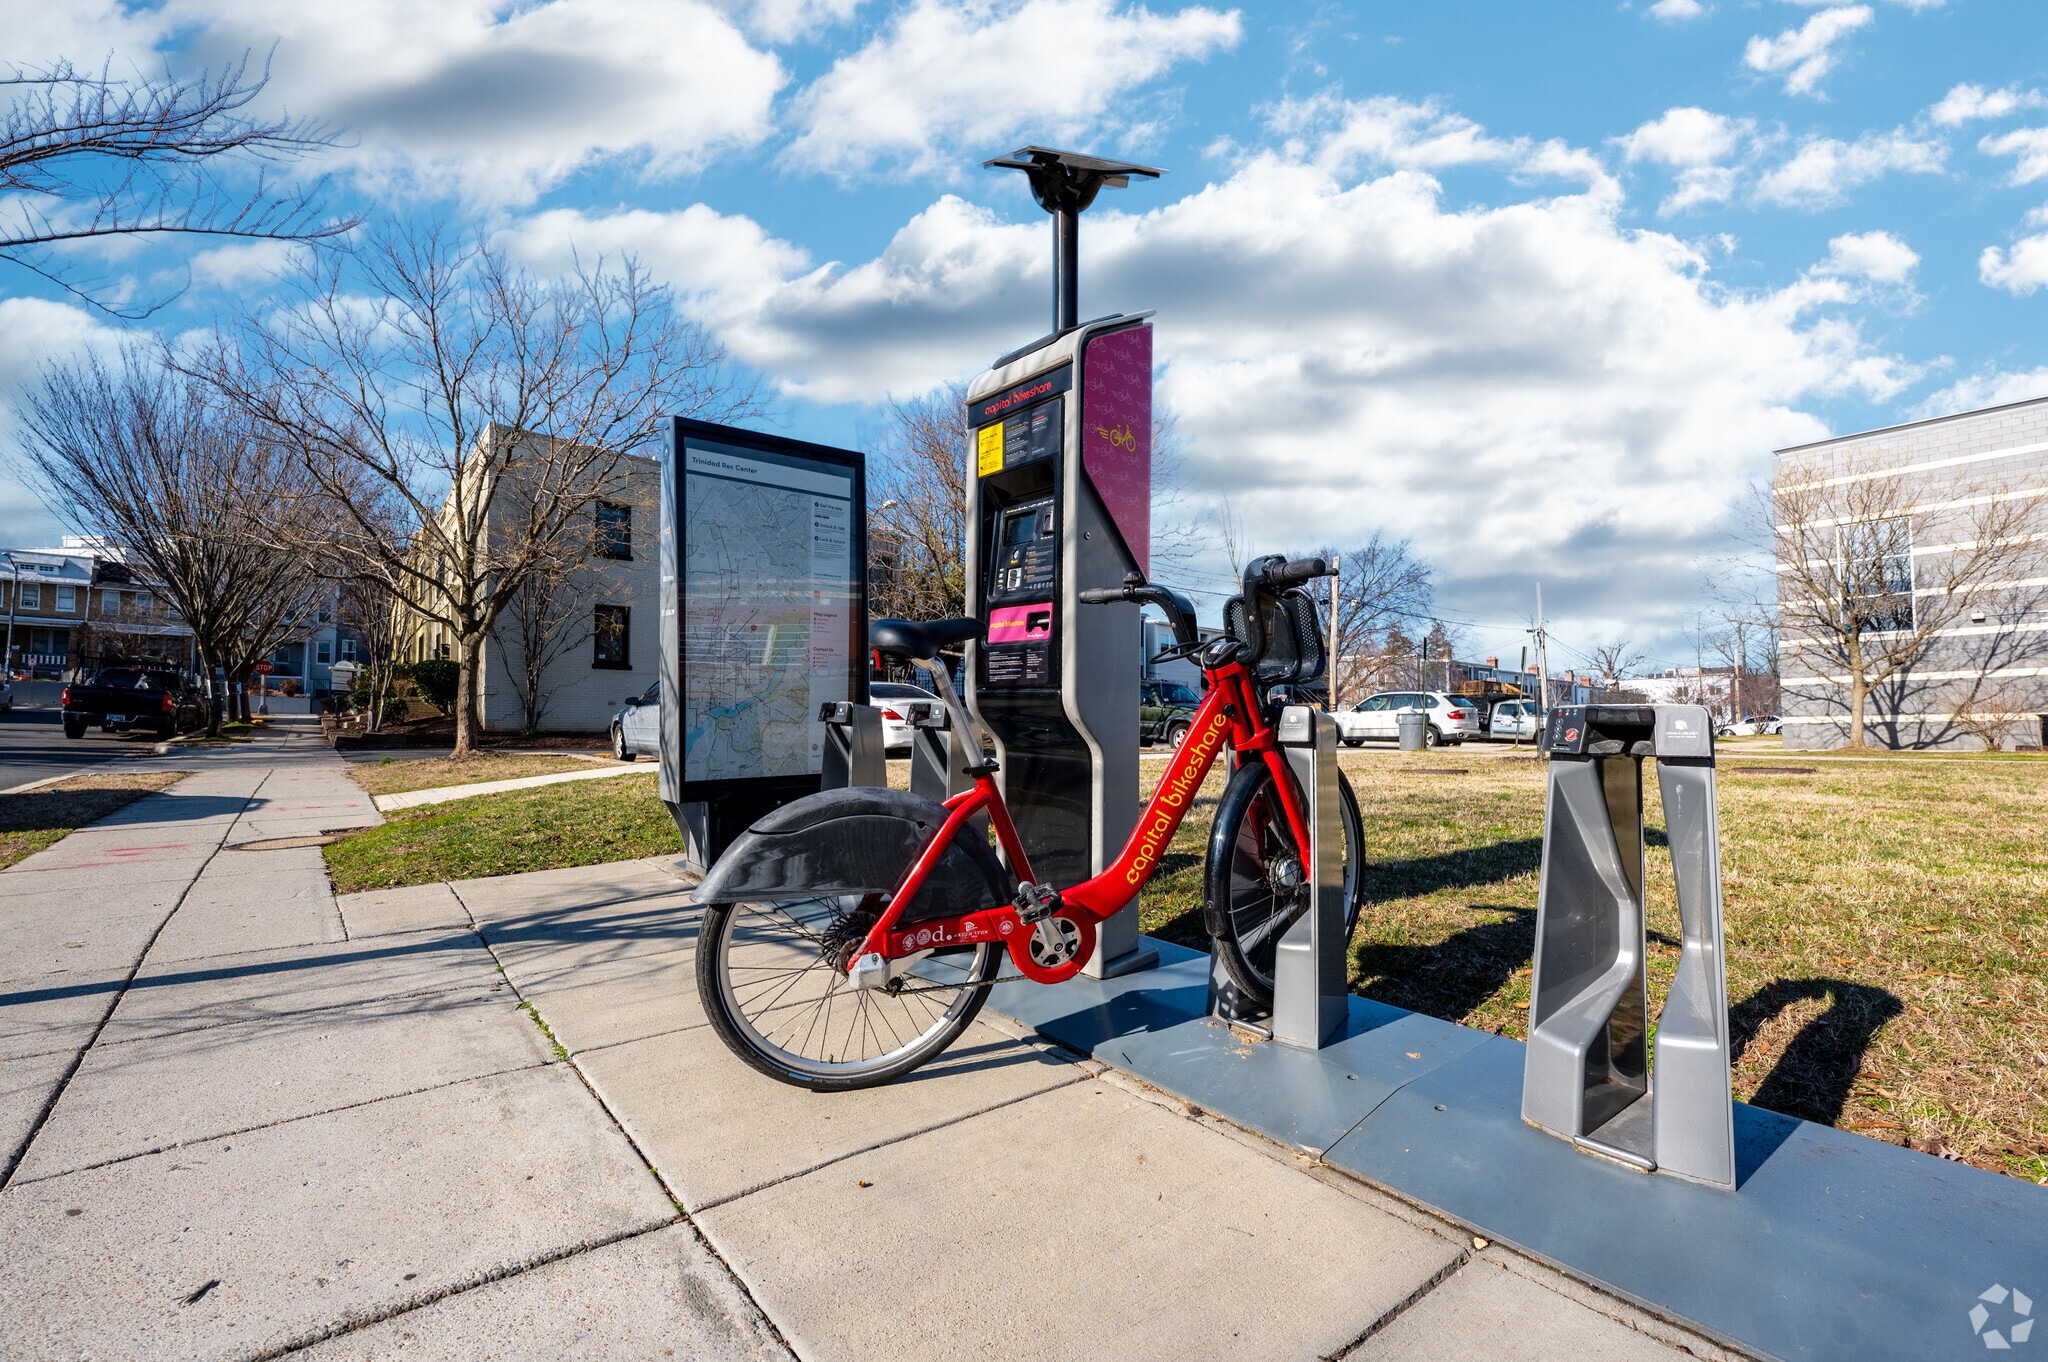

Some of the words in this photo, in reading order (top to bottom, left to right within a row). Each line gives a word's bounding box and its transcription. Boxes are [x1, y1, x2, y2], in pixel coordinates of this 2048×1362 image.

[984, 395, 1011, 415] capital
[1012, 381, 1052, 403] bikeshare
[692, 456, 720, 468] Trinidad
[722, 462, 734, 470] Rec
[735, 464, 757, 474] Center
[1126, 809, 1172, 885] capital
[1160, 713, 1227, 807] bikeshare
